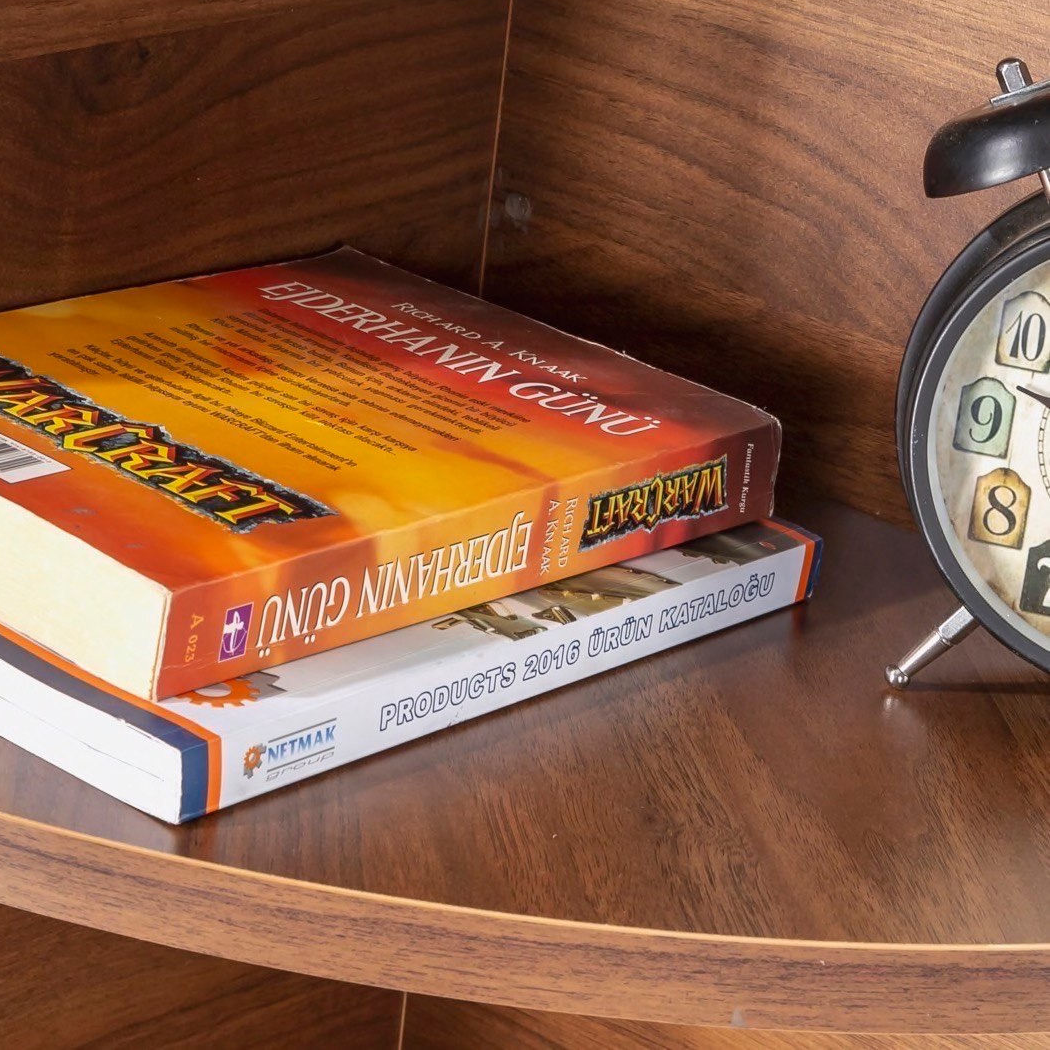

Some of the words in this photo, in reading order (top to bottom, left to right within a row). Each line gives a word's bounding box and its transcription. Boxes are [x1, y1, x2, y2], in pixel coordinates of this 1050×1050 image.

[258, 281, 522, 384] EJDERHANIN
[508, 382, 661, 436] GÜNÜ
[391, 302, 481, 340] RICHARD
[481, 341, 504, 351] A.
[509, 350, 589, 384] KNAAK
[1005, 313, 1046, 362] 10
[969, 395, 1003, 443] 9
[587, 465, 724, 535] WARCRAFT
[982, 485, 1017, 536] 8
[539, 520, 554, 577] KNAAK
[558, 496, 579, 568] RICHARD
[356, 511, 533, 618] EJDERHANIN
[189, 613, 204, 630] A
[255, 576, 350, 658] GÜNÜ
[184, 633, 199, 663] 023
[379, 662, 517, 731] PRODUCTS
[522, 638, 580, 681] 2016
[587, 612, 652, 658] ÜRÜN
[658, 572, 776, 632] KATALOĞU
[265, 751, 335, 782] group
[267, 724, 337, 764] NETMAK
